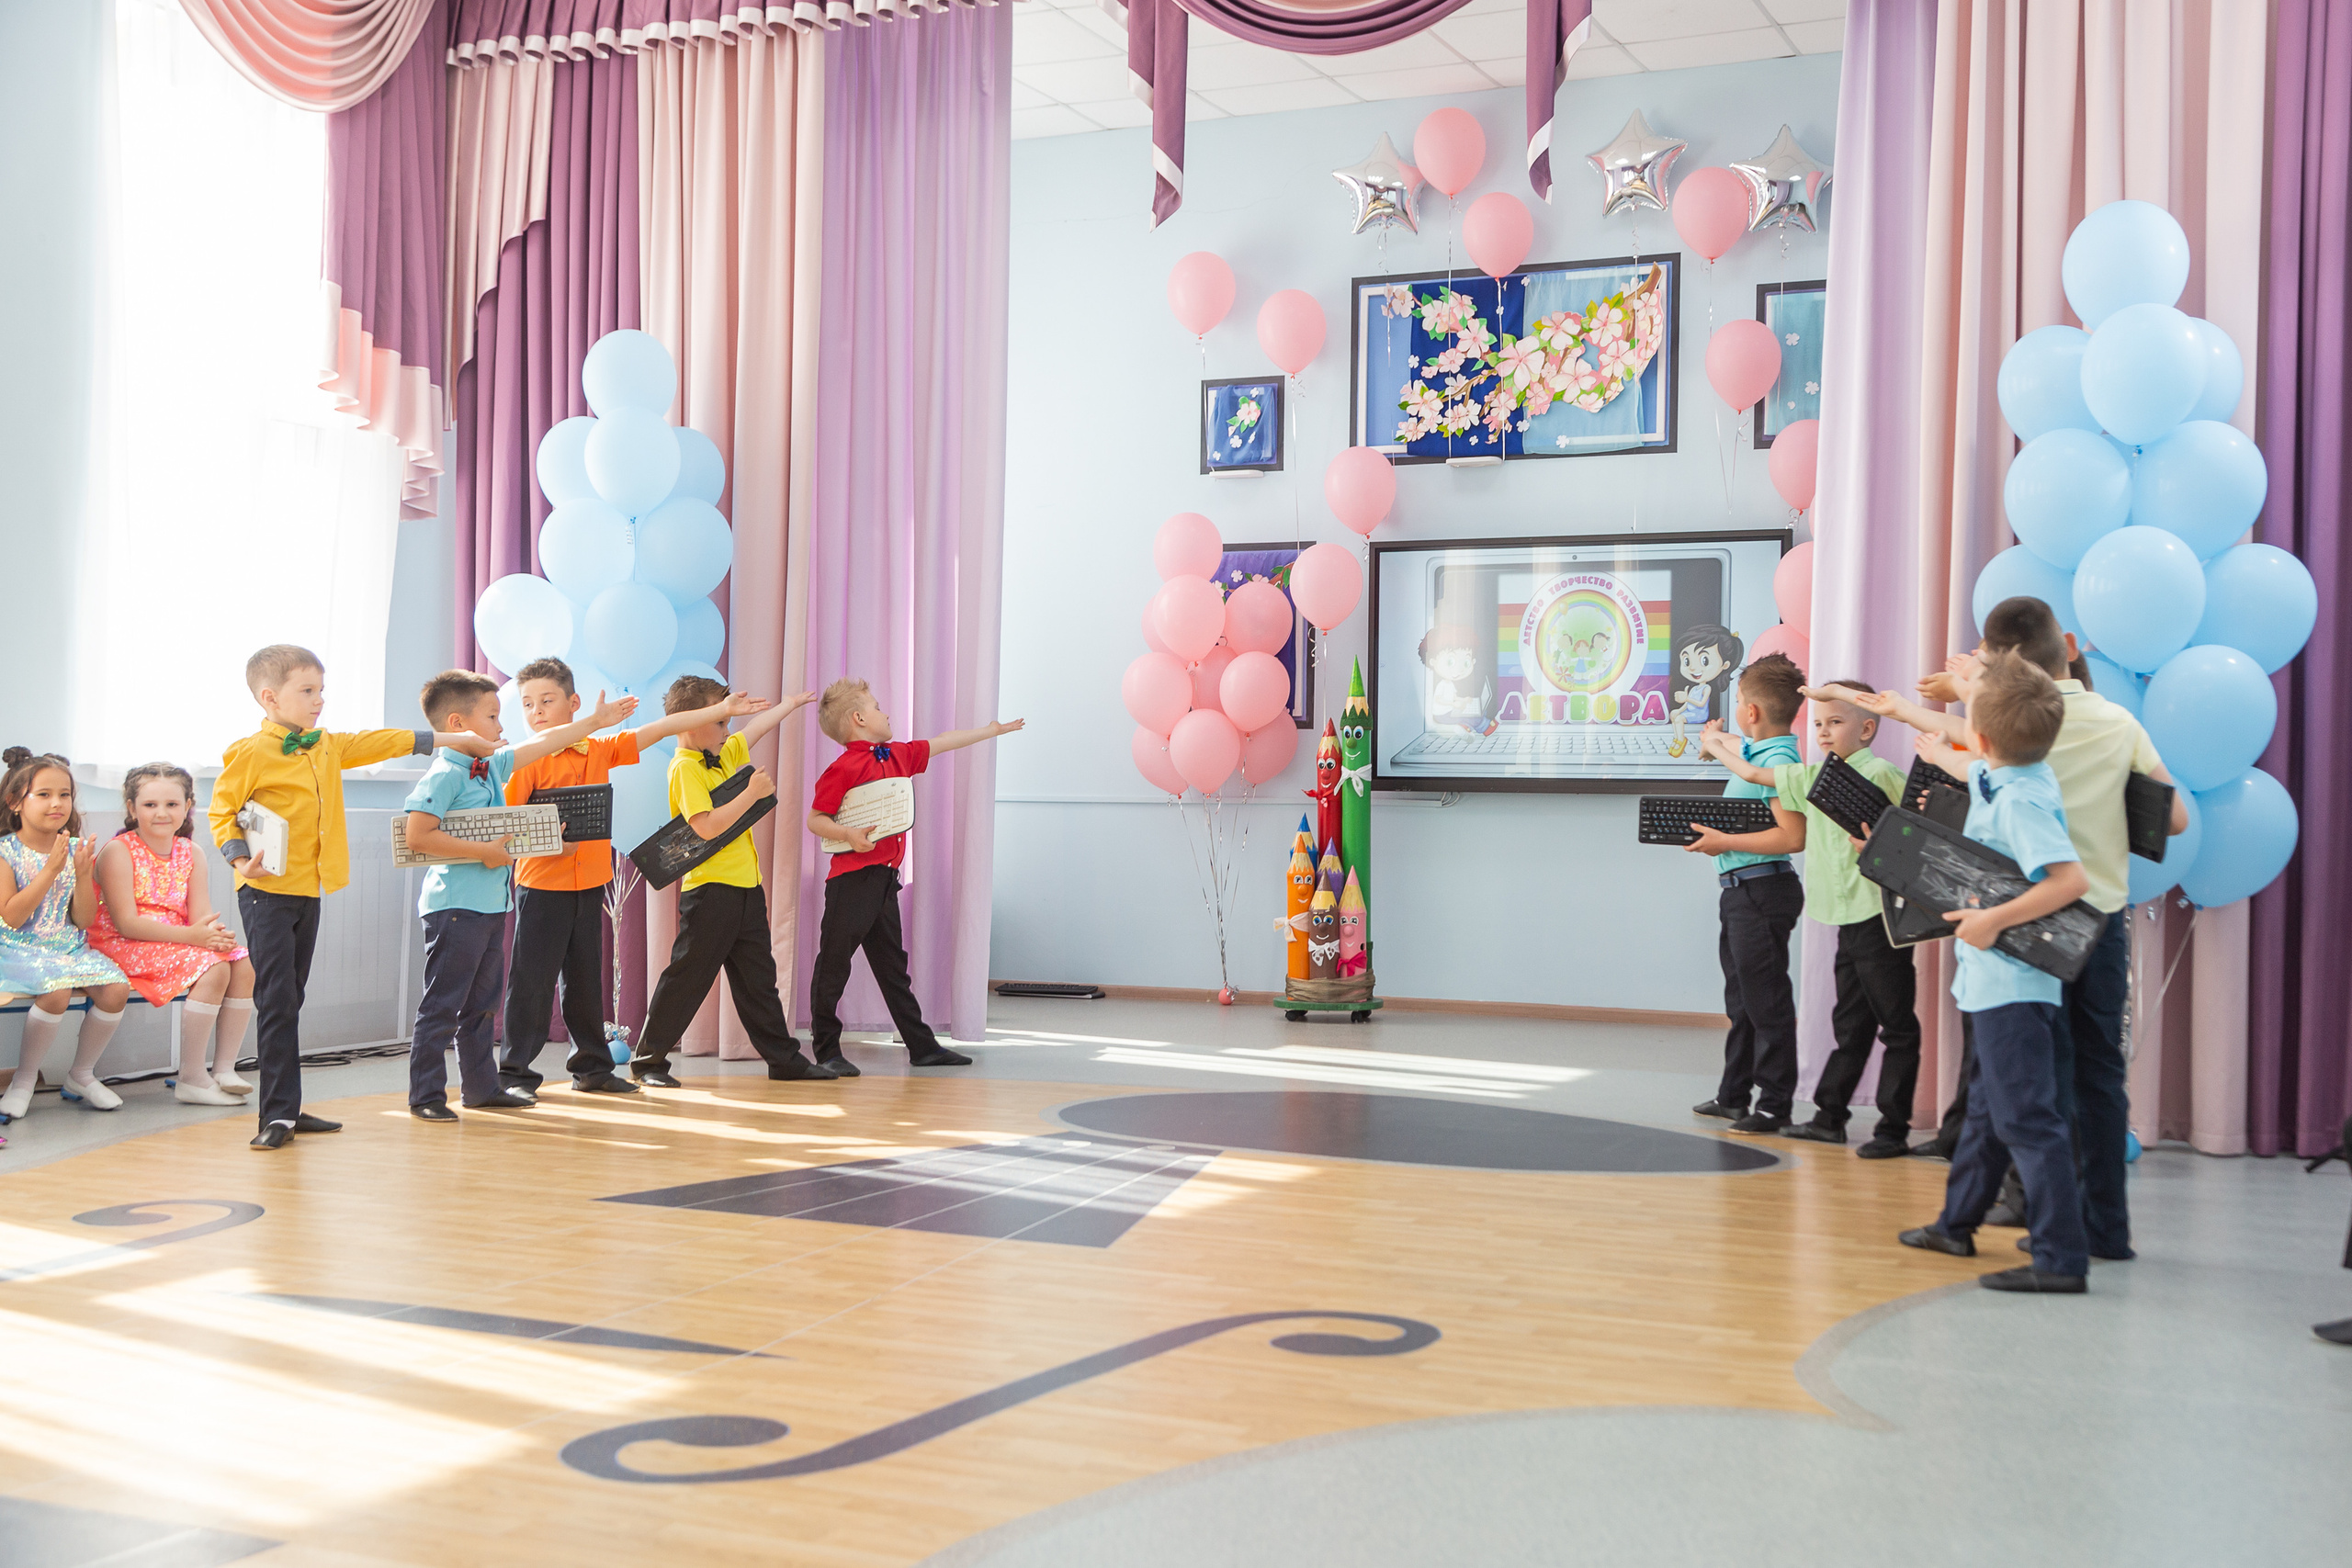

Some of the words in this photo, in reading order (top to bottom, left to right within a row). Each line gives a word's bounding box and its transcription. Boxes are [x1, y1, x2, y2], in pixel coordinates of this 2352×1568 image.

[1523, 599, 1544, 646] ДЕТСТВО
[1548, 576, 1613, 595] ТВОРЧЕСТВО
[1616, 589, 1644, 644] РАЗВИТИЕ
[1499, 694, 1666, 721] ДЕТВОРА
